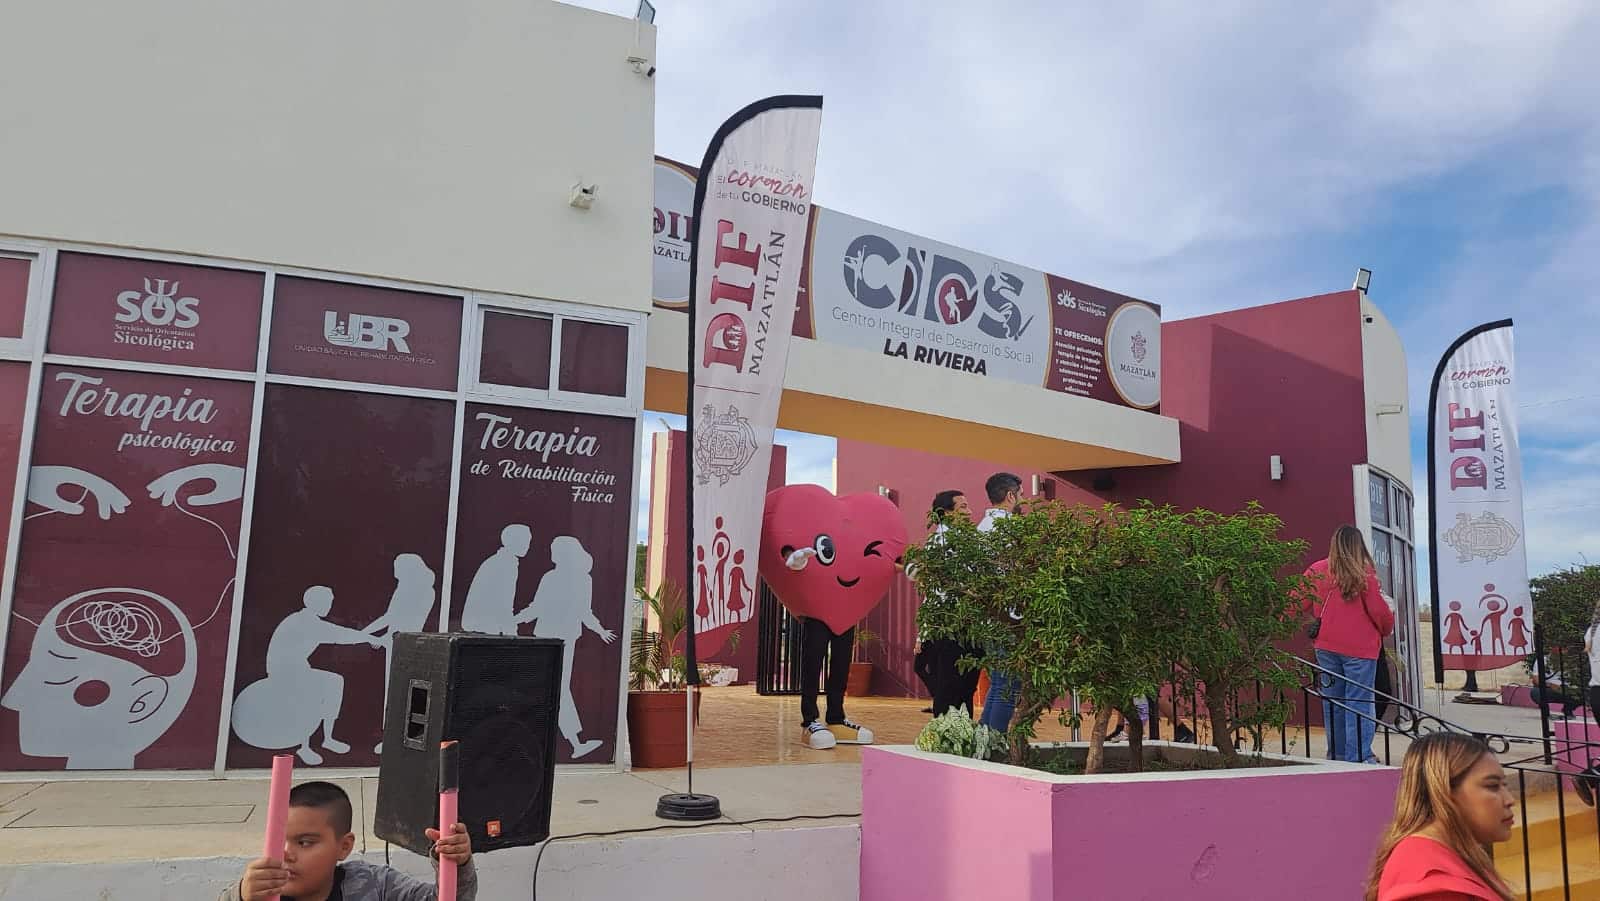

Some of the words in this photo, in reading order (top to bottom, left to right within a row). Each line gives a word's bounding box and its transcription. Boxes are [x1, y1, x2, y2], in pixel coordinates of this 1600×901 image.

[728, 169, 807, 199] corazón
[742, 191, 806, 215] GOBIERNO
[703, 218, 761, 374] DIF
[749, 230, 786, 376] MAZATLÁN
[1057, 289, 1077, 309] SOS
[113, 331, 195, 351] Sicológica
[324, 310, 411, 353] UBR
[832, 306, 875, 329] Centro
[879, 317, 925, 339] Integral
[927, 330, 943, 344] de
[946, 333, 1000, 357] Desarrollo
[1003, 346, 1035, 365] Social
[883, 338, 908, 360] LA
[914, 345, 987, 376] RIVIERA
[55, 371, 219, 432] Terapia
[117, 430, 237, 457] psicológica
[476, 412, 601, 463] Terapia
[1448, 402, 1488, 491] DIF
[470, 459, 491, 476] de
